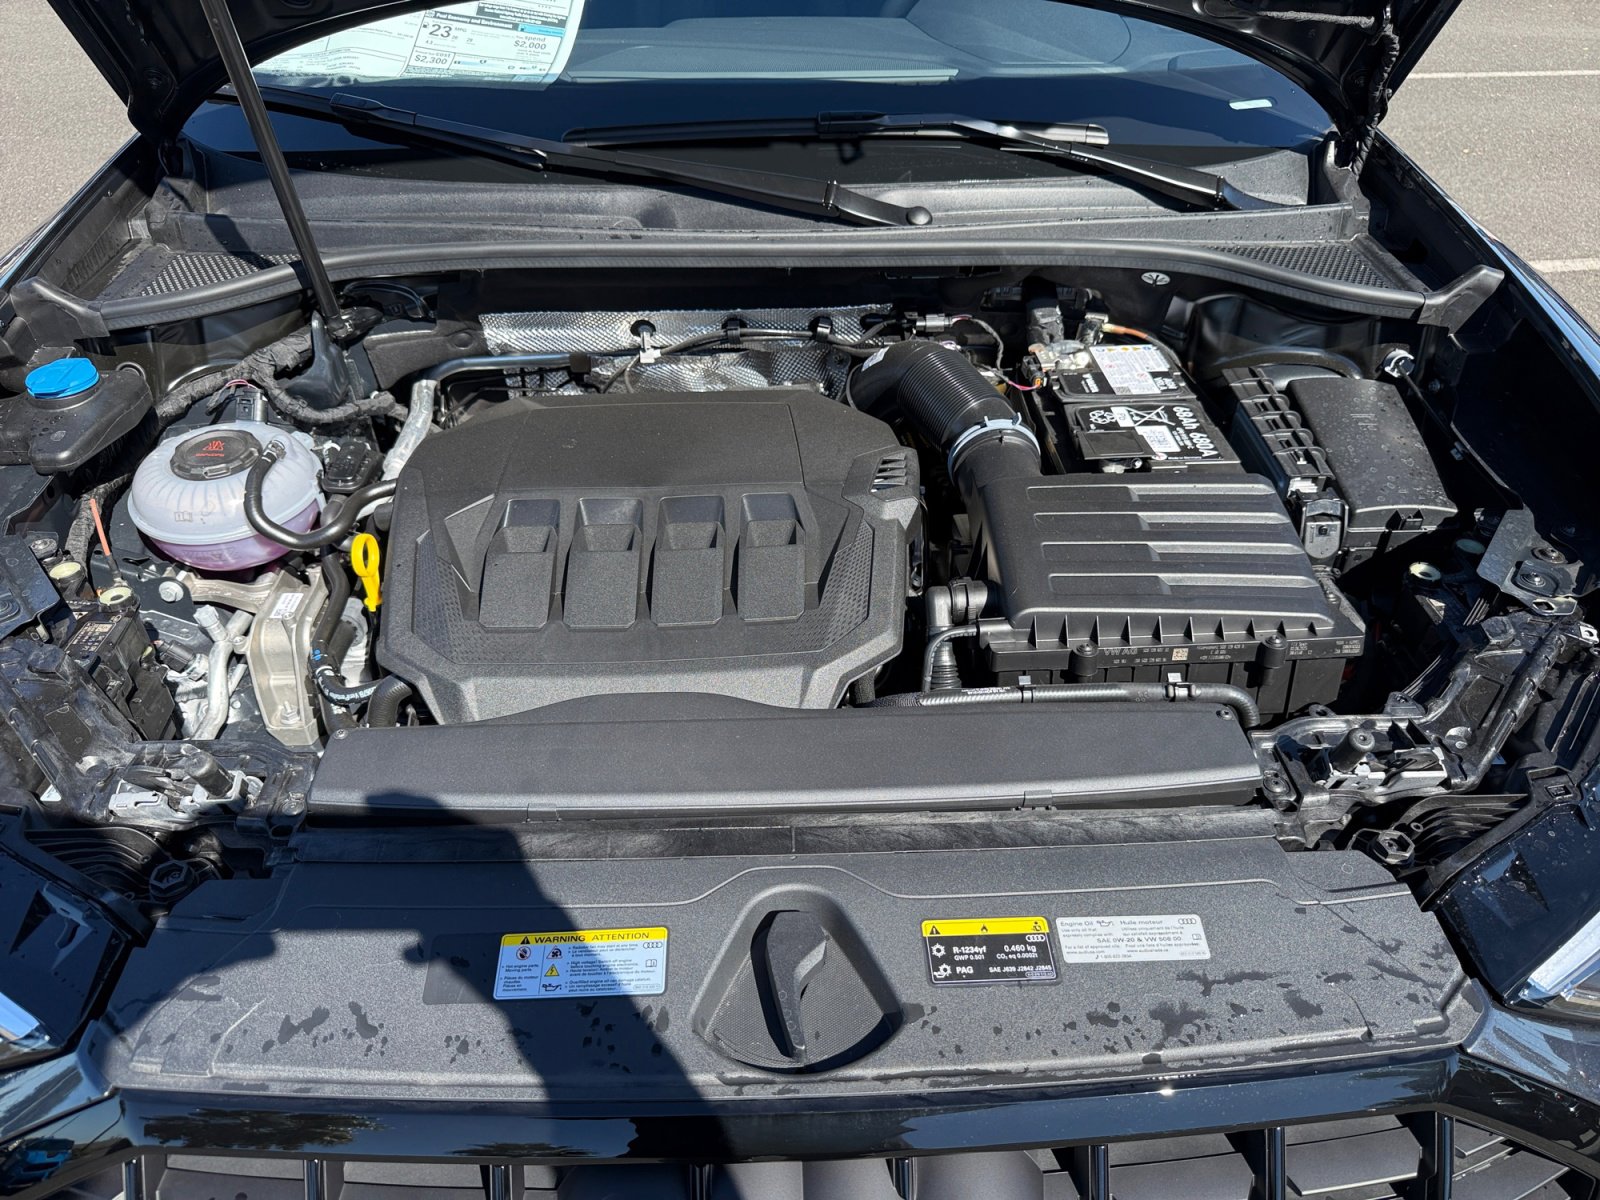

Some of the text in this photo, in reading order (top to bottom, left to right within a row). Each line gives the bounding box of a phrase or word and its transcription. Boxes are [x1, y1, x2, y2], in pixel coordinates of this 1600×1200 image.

[429, 24, 452, 38] 23
[514, 40, 546, 50] $2,000
[414, 55, 447, 64] $2,300
[1172, 406, 1200, 430] 68Ah
[534, 932, 650, 943] WARNING ATTENTION
[952, 944, 1037, 954] R-1234yf 0.460 kg
[956, 966, 974, 974] PAG
